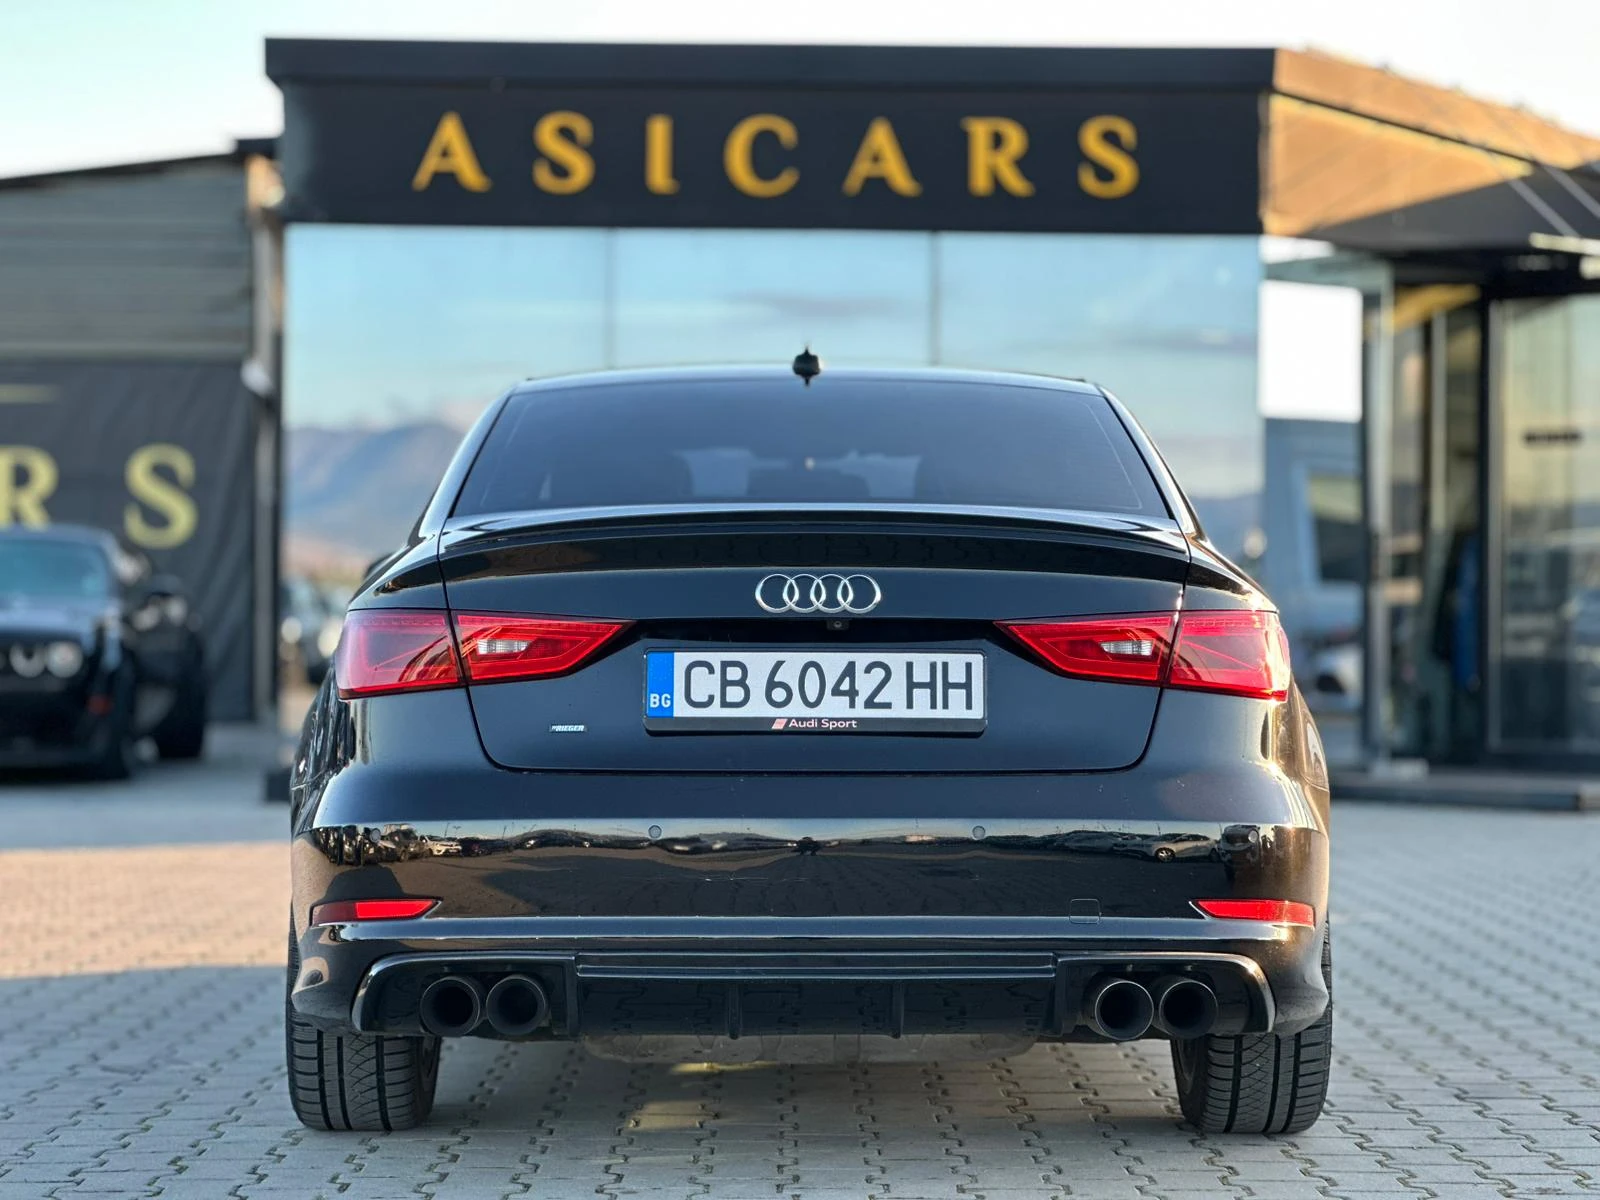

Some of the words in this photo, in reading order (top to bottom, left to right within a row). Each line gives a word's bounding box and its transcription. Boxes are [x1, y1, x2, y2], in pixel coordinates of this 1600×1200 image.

[411, 110, 1140, 199] ASICARS
[649, 693, 672, 708] BG
[684, 660, 751, 709] CB
[764, 660, 893, 710] 6042
[905, 661, 973, 711] HH
[788, 718, 818, 728] Audi
[821, 719, 857, 730] Sport
